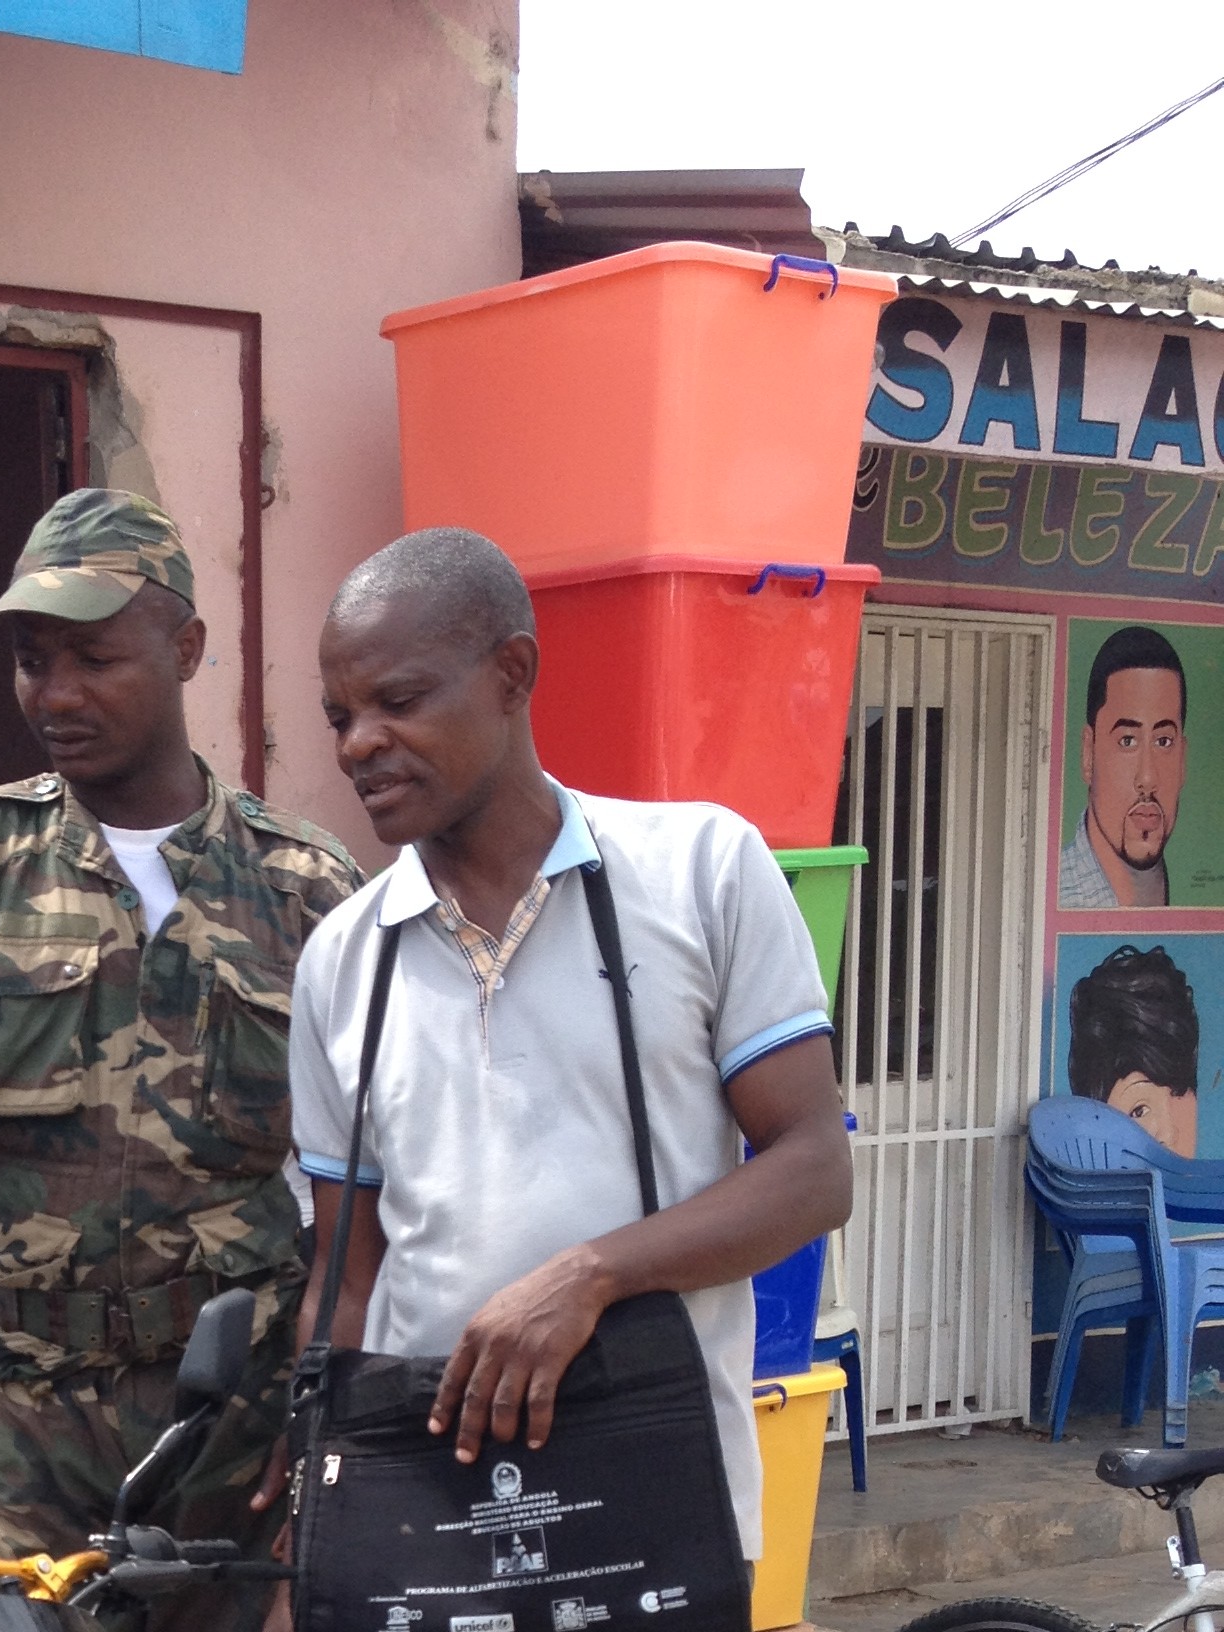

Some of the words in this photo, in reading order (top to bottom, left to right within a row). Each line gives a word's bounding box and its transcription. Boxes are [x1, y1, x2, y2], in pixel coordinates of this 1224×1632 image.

[865, 297, 1224, 469] SALA
[575, 1500, 604, 1511] GERAL
[405, 1587, 454, 1595] PROGRAMA
[456, 1586, 466, 1594] DE
[544, 1566, 604, 1583] ACELERAÇÃO
[605, 1560, 645, 1574] ESCOLAR
[455, 1620, 494, 1632] unicef
